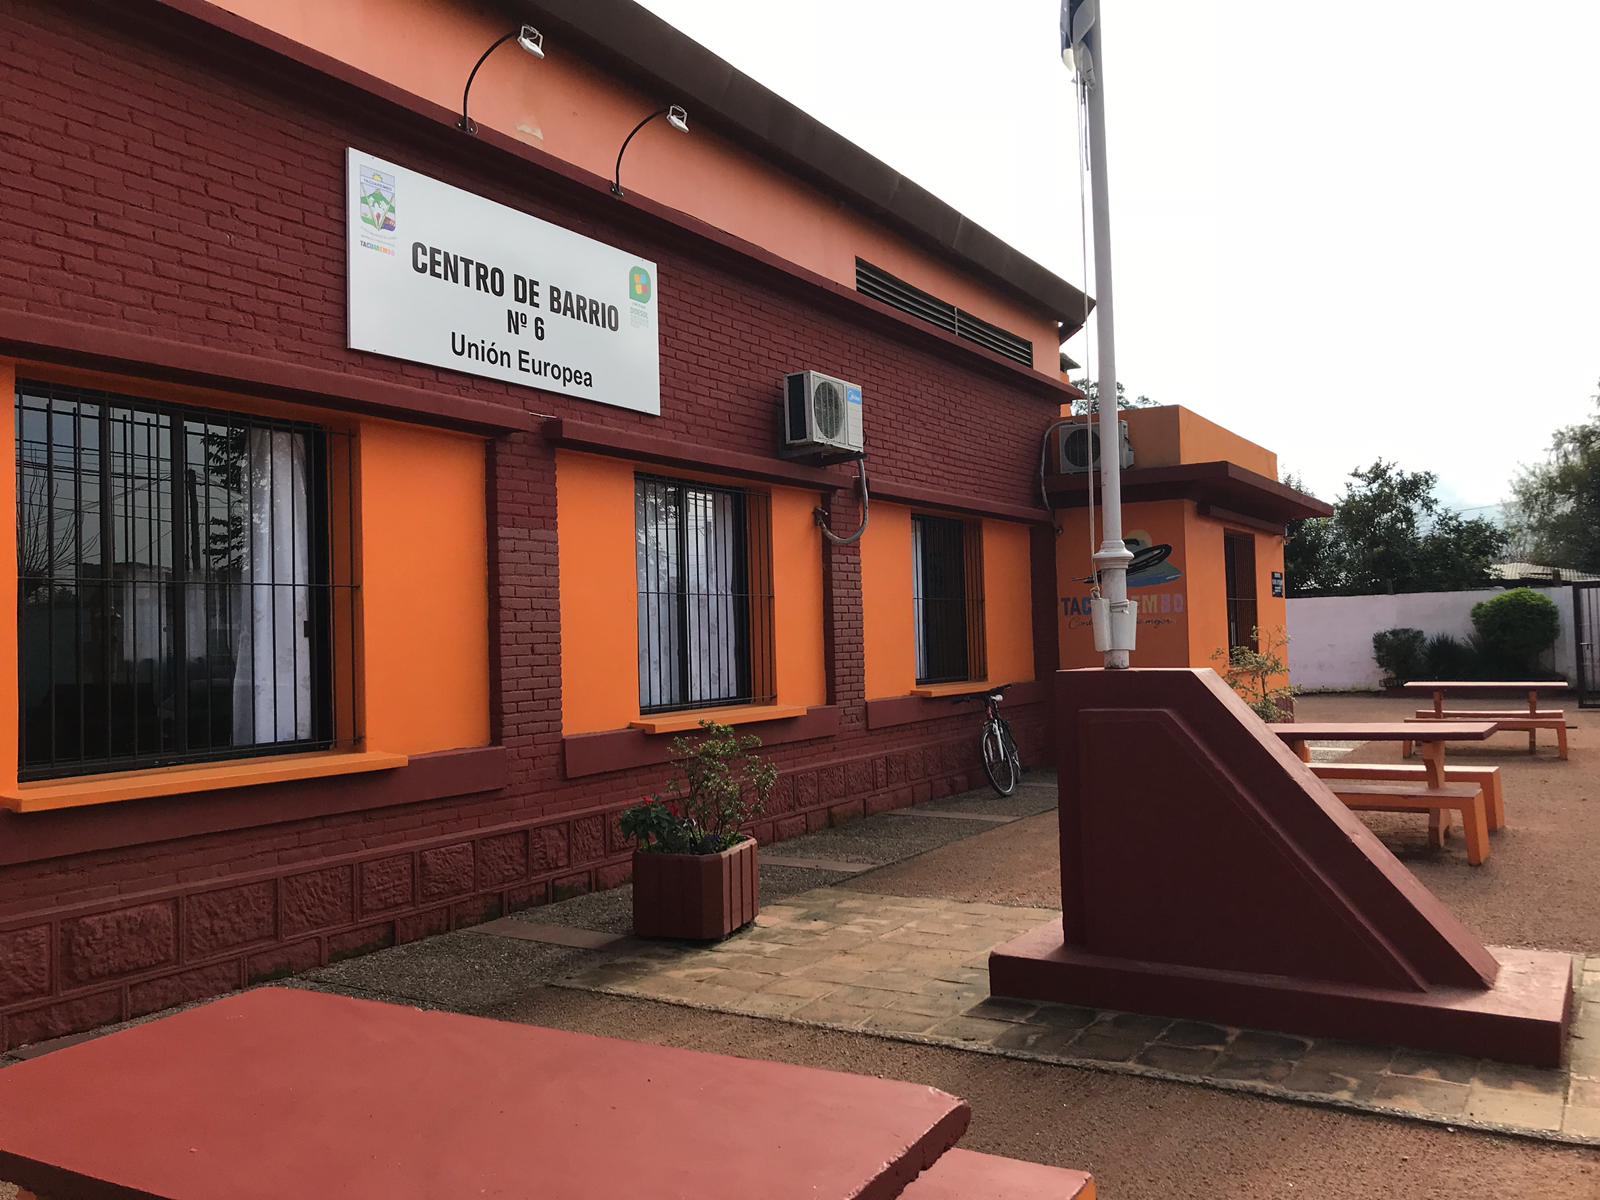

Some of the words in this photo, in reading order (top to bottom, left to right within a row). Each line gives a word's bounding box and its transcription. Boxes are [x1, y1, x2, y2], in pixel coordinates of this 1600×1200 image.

[411, 241, 504, 297] CENTRO
[514, 273, 540, 308] DE
[549, 285, 619, 332] BARRIO
[534, 317, 545, 341] 6
[451, 331, 511, 368] Unión
[518, 349, 593, 388] Europea
